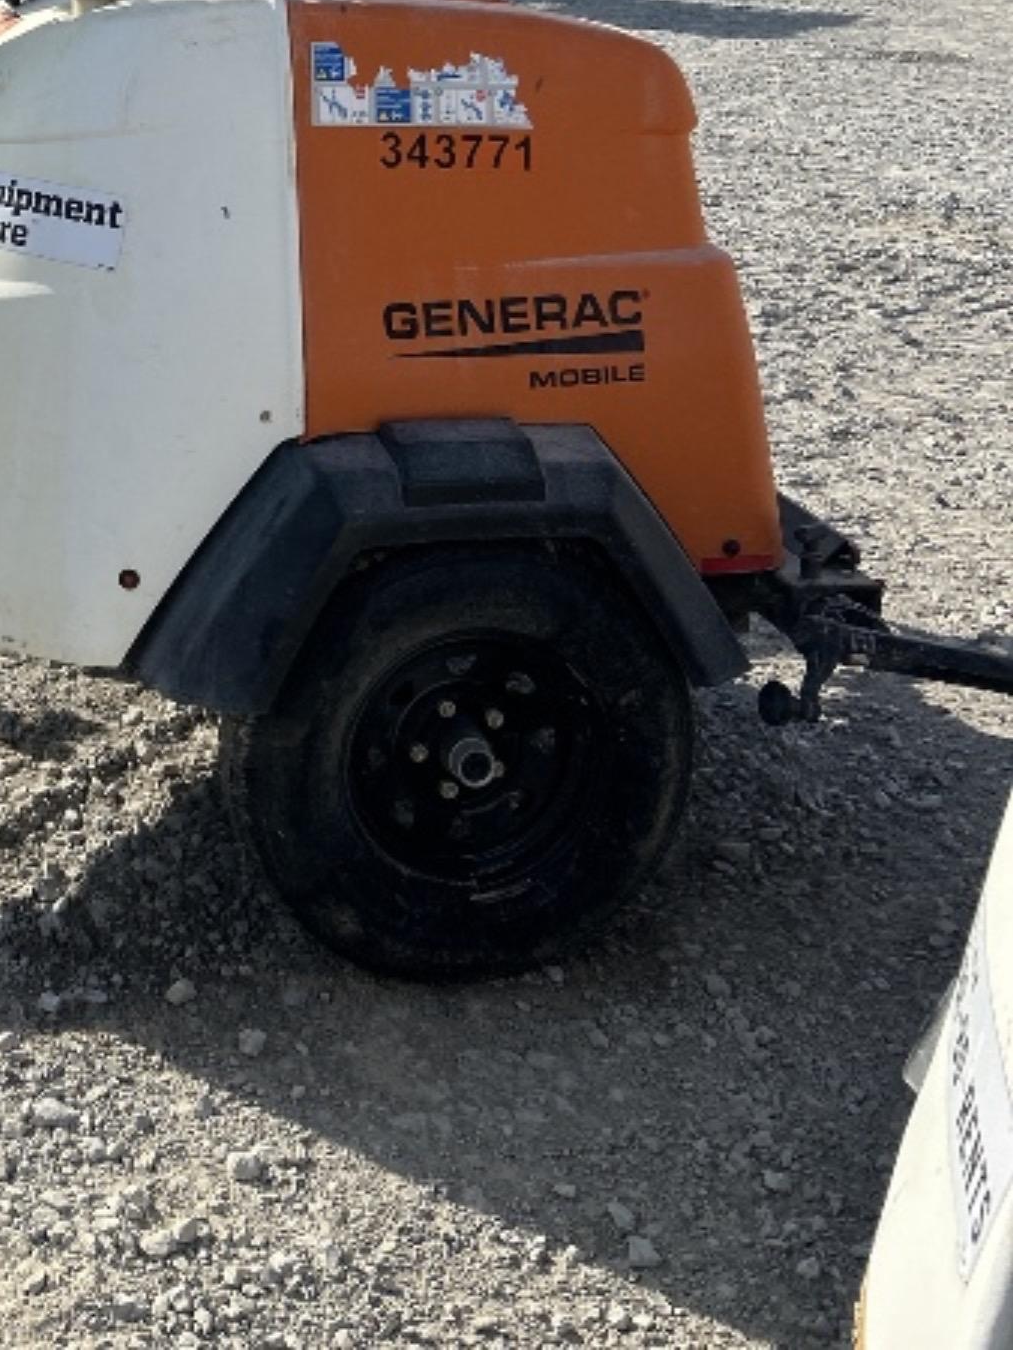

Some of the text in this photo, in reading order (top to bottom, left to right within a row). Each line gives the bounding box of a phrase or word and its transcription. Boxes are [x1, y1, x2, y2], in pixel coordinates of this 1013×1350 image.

[380, 131, 532, 171] 343771
[383, 290, 643, 339] GENERAC
[529, 363, 645, 389] MOBILE
